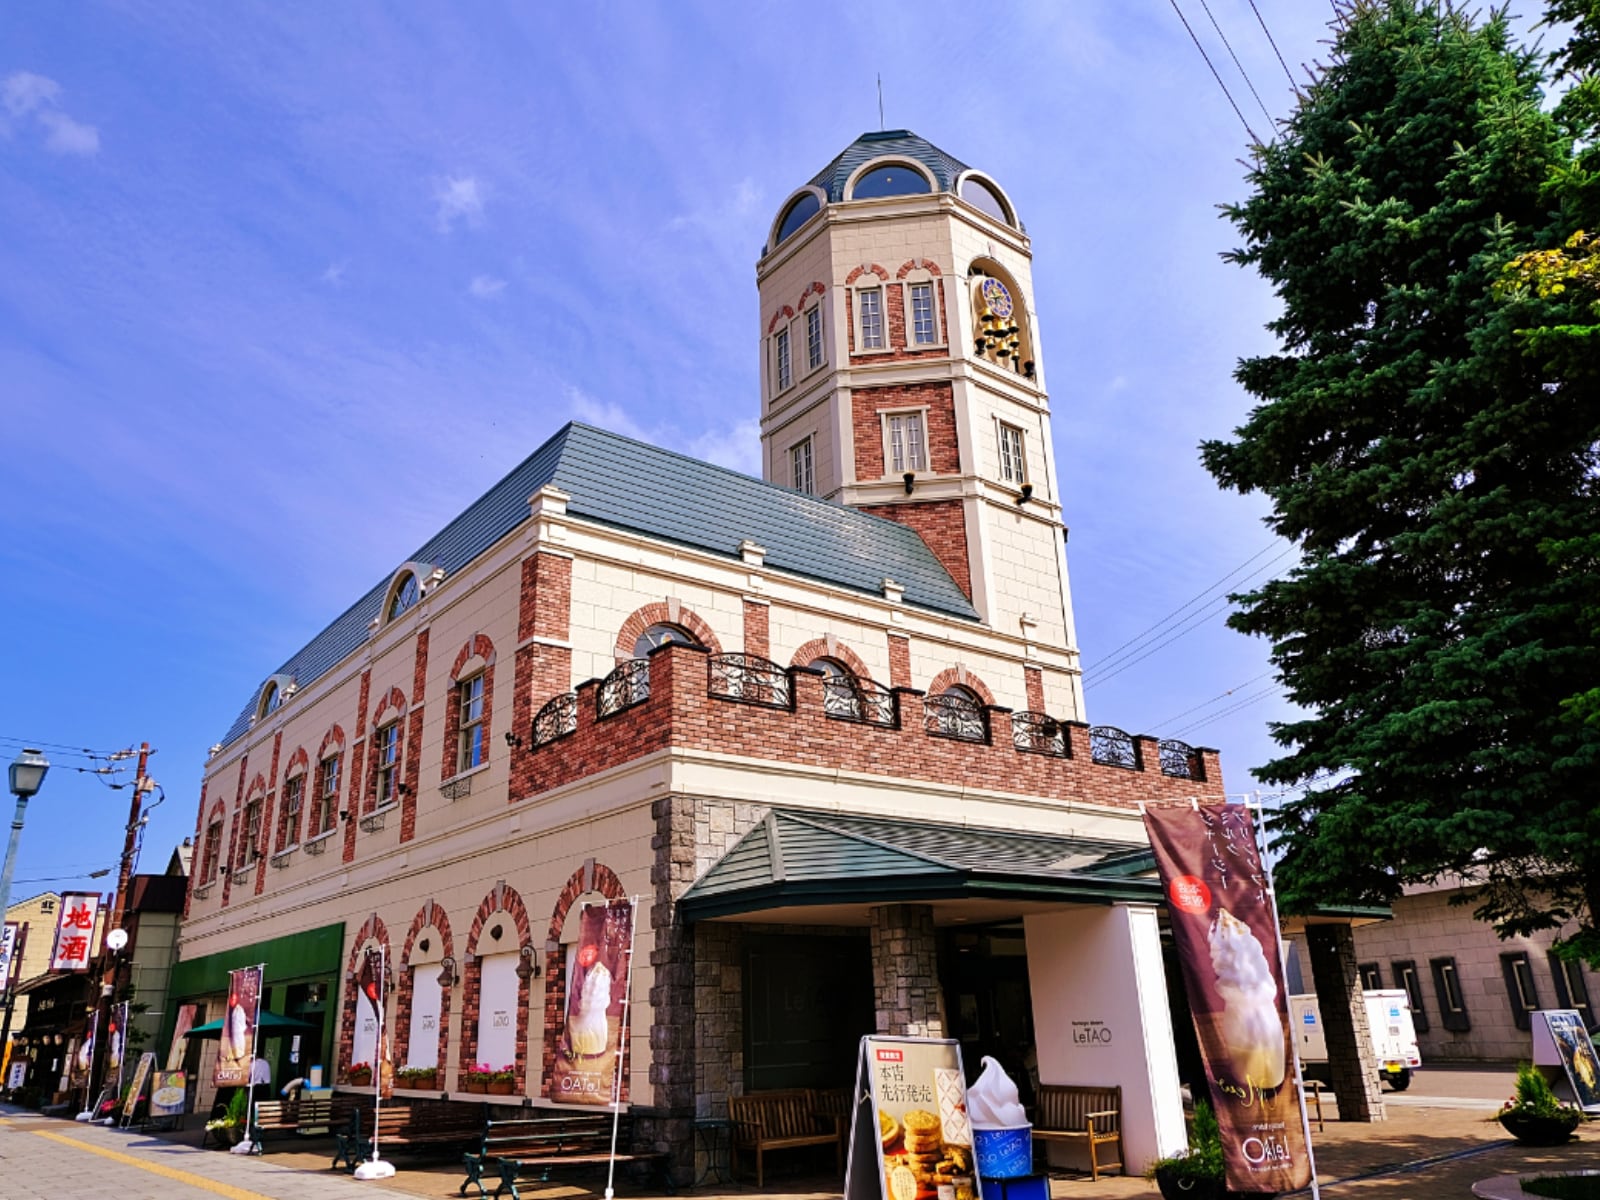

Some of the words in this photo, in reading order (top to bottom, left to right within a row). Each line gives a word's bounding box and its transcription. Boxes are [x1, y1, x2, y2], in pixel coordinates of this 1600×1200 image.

[59, 903, 92, 962] 地酒
[1072, 1027, 1112, 1043] LeTAO
[880, 1064, 904, 1081] 本店
[881, 1083, 932, 1103] 先行発売
